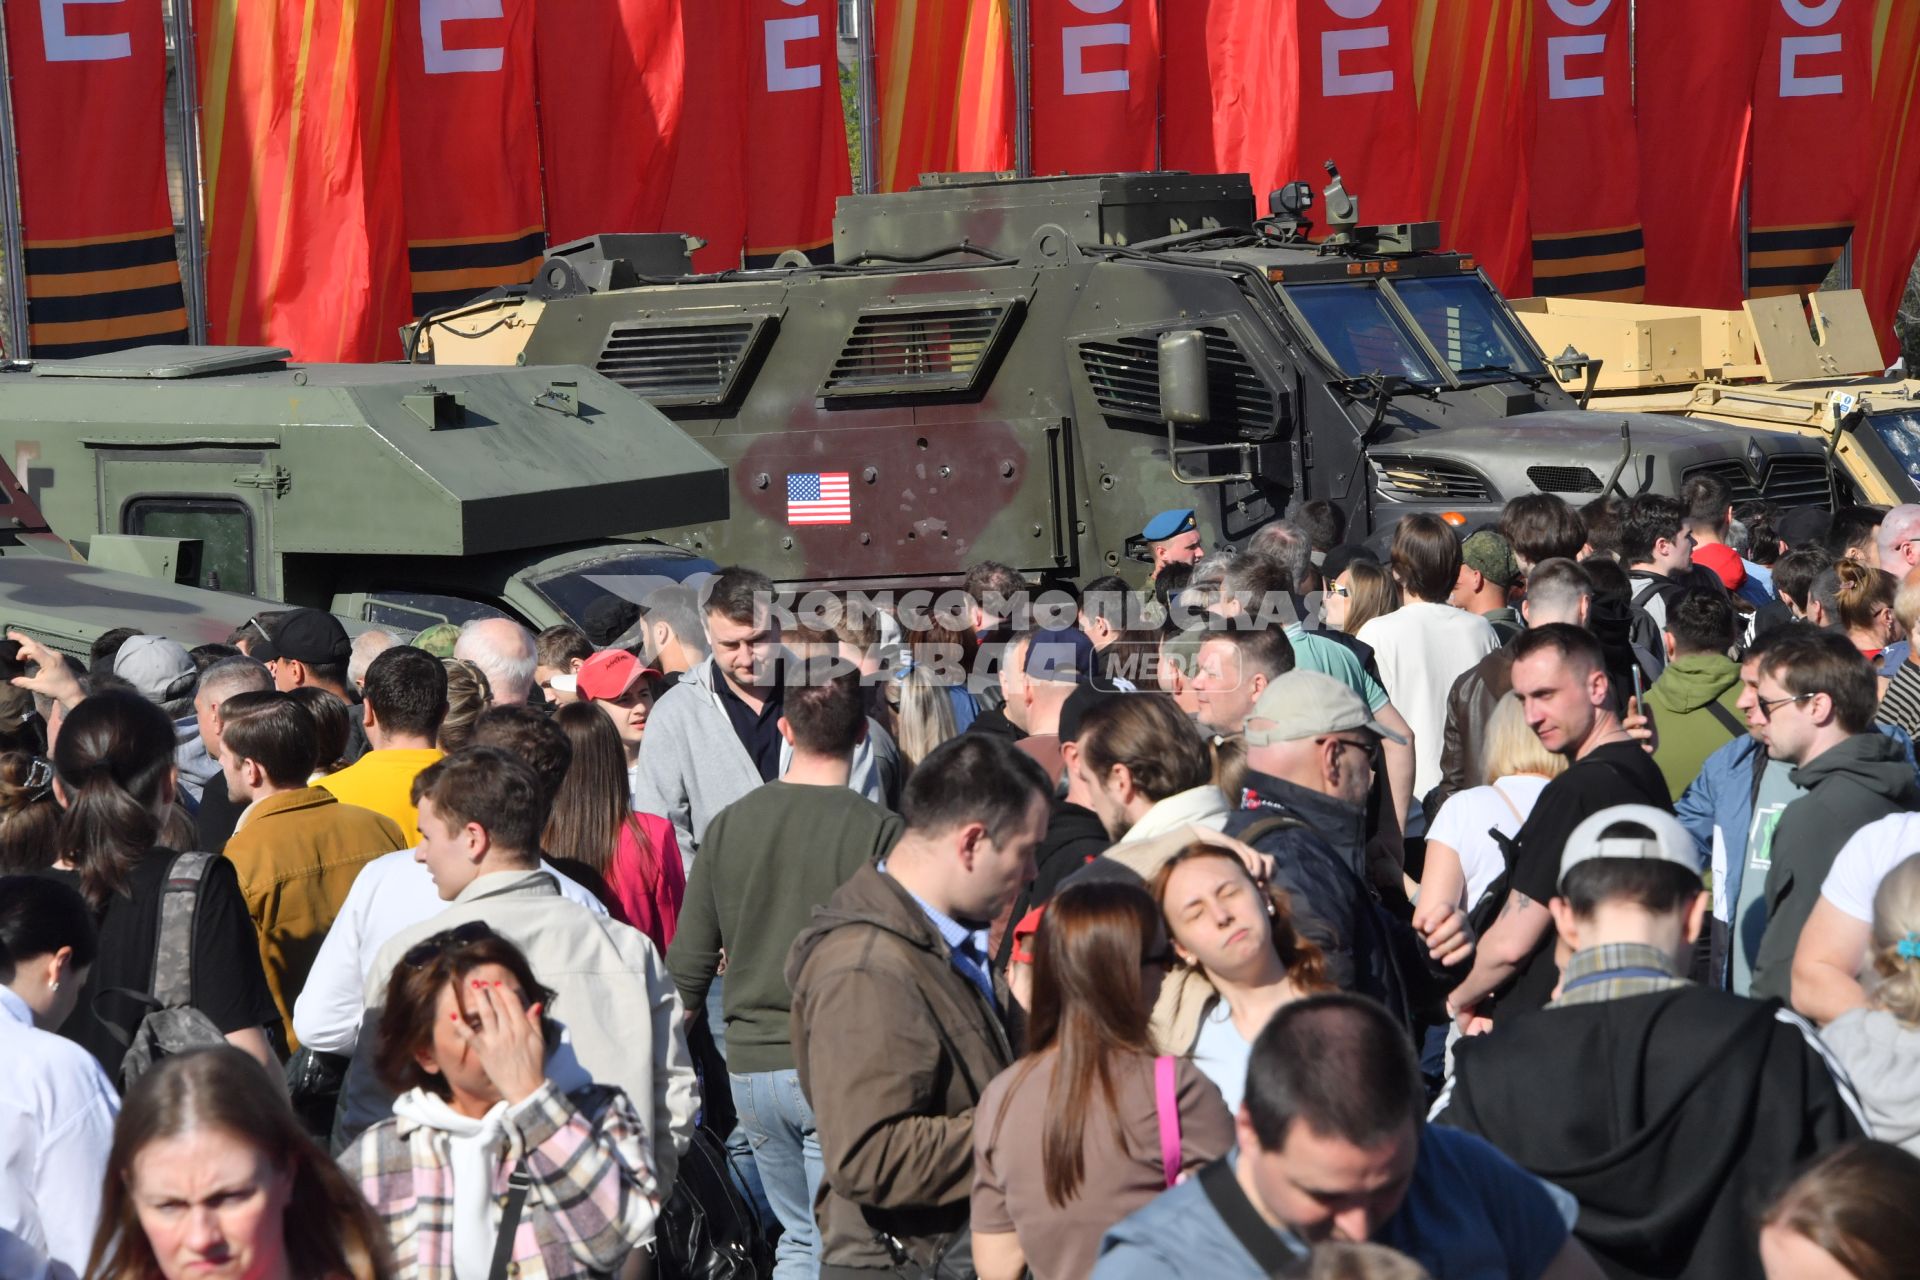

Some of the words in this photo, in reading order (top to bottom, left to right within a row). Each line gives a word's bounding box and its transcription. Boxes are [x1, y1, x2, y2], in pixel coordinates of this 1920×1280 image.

[764, 0, 821, 92] П
[1062, 0, 1130, 95] П
[1321, 0, 1394, 97] П
